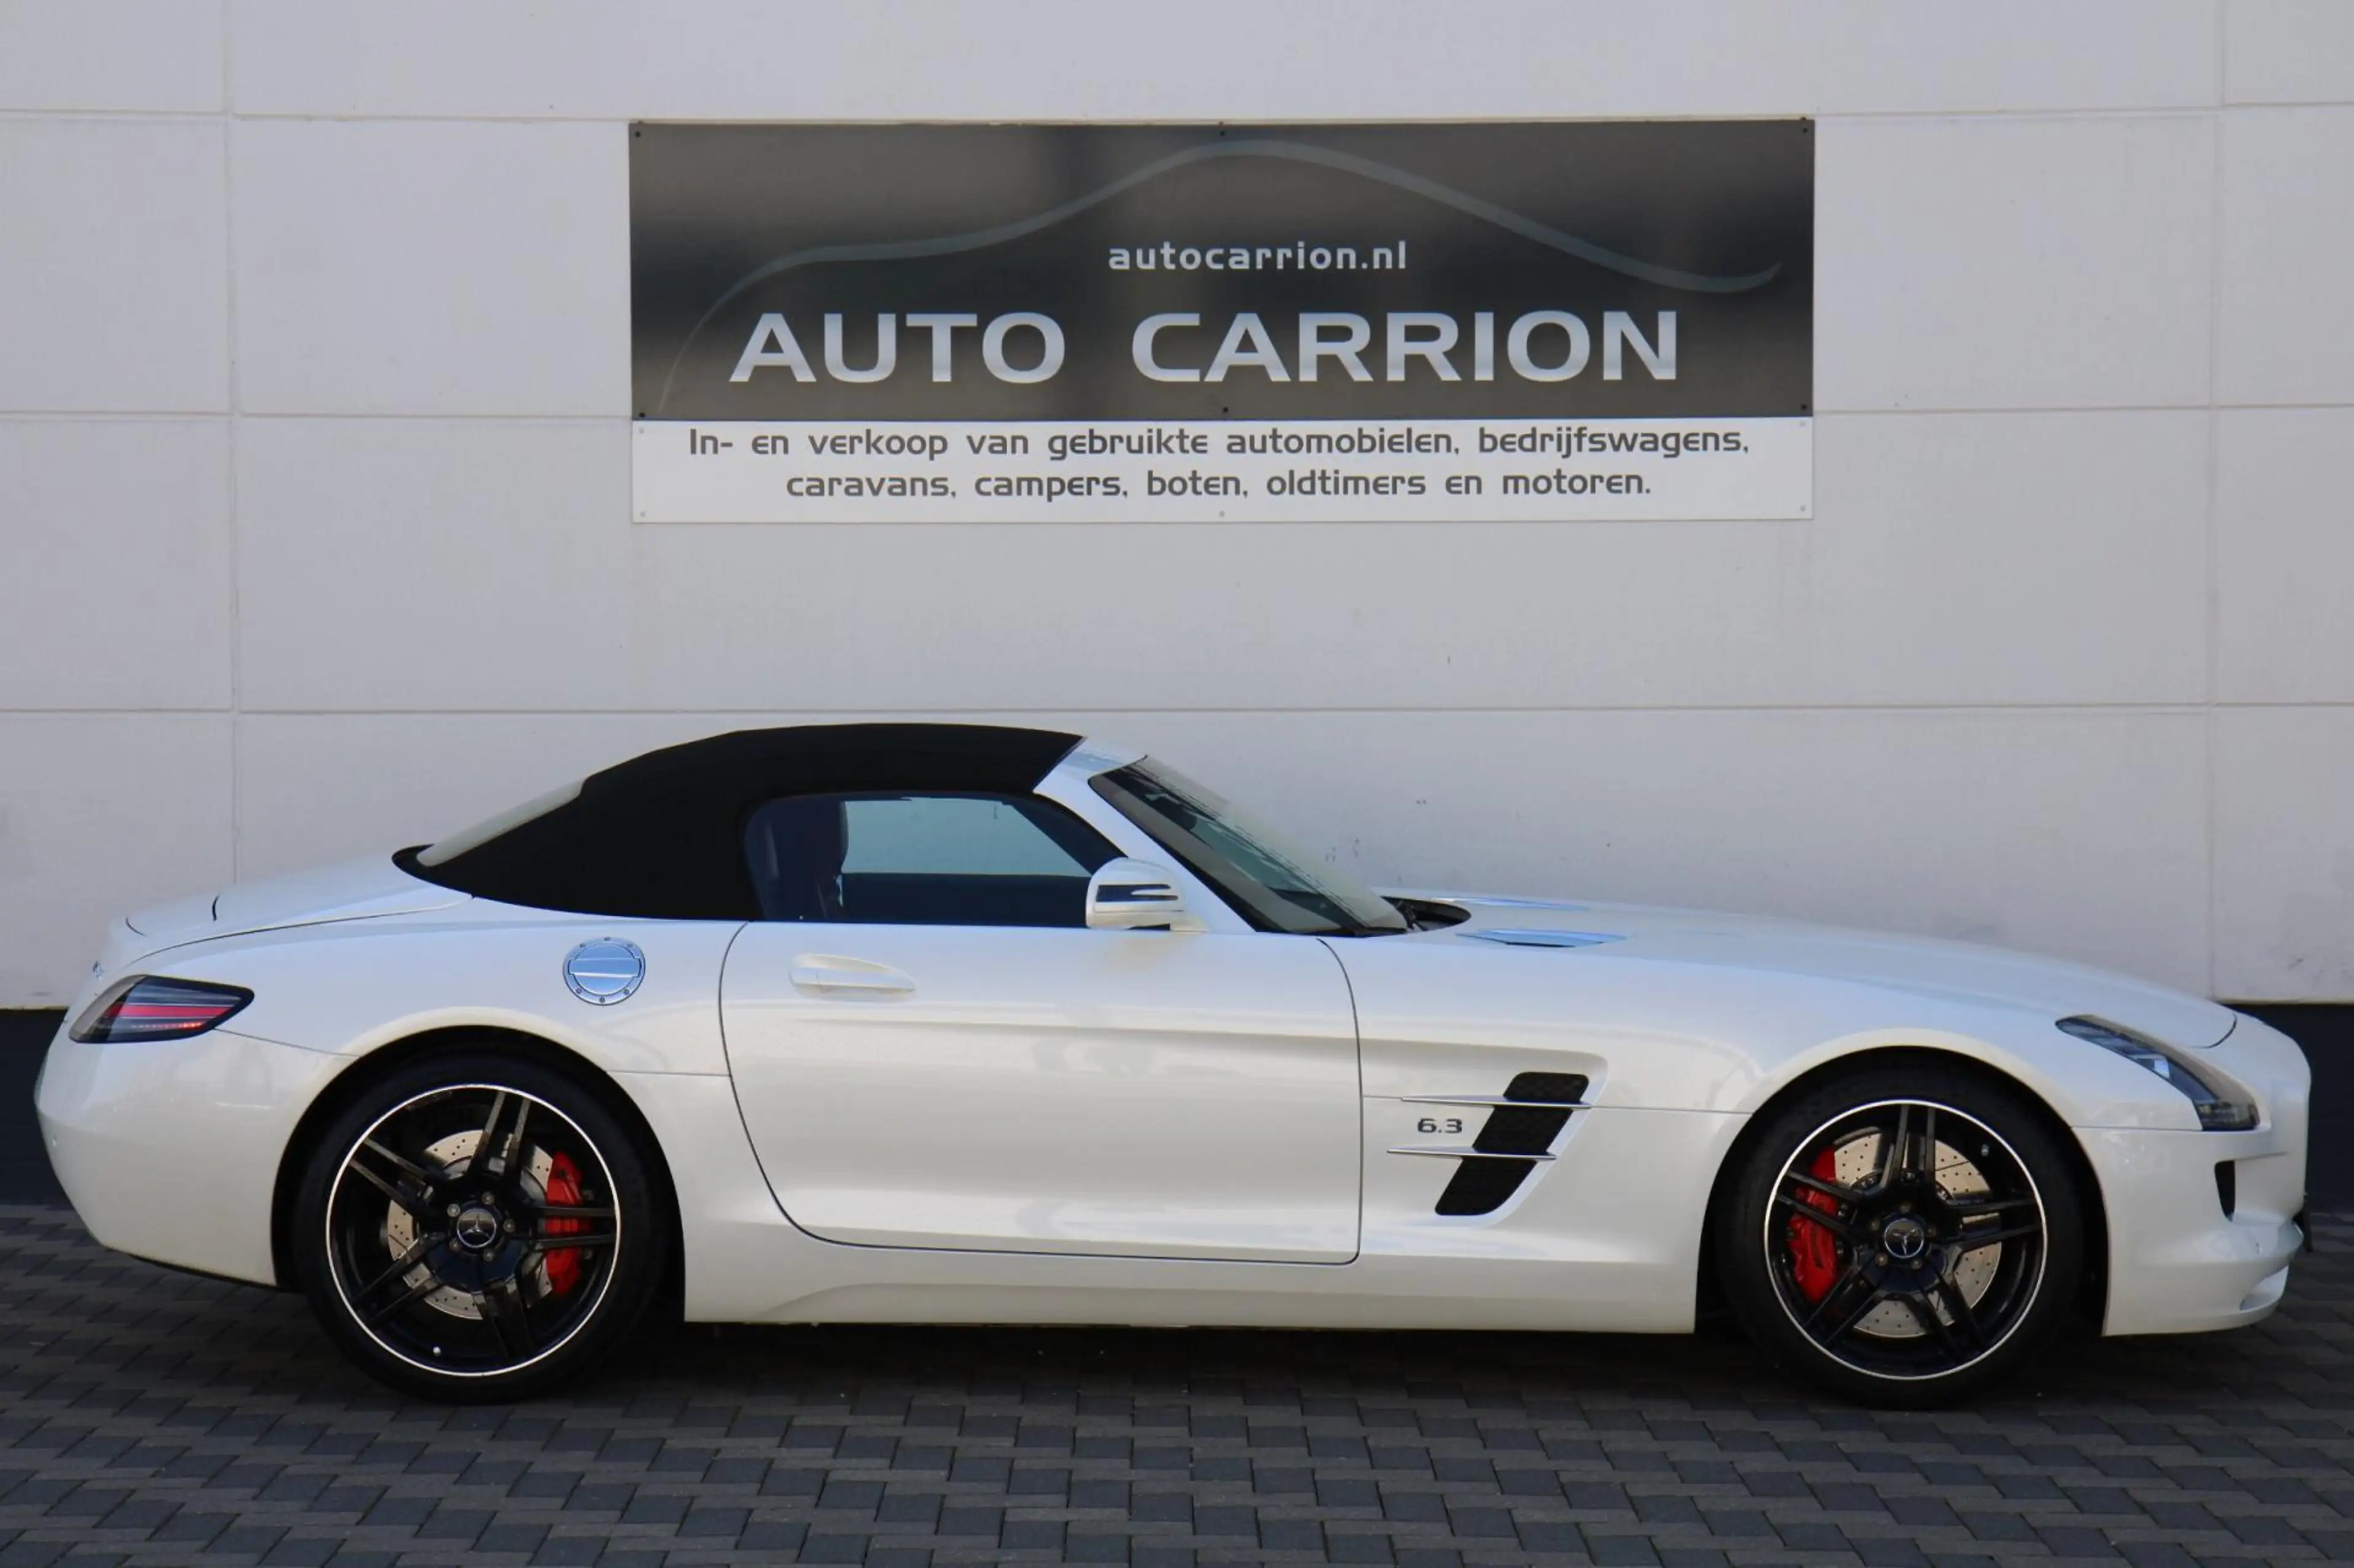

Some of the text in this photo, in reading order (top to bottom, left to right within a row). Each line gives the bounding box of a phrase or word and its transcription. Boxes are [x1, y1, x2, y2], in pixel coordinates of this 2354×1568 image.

[1109, 241, 1405, 270] autocarrion.nl
[729, 310, 1676, 383] AUTO CARRION
[690, 427, 1748, 461] In- en verkoop van gebruikte automobielen, bedrijfswagens,
[787, 469, 1650, 502] caravans, campers, boten, oldtimers en motoren.
[1417, 1117, 1462, 1133] 6.3
